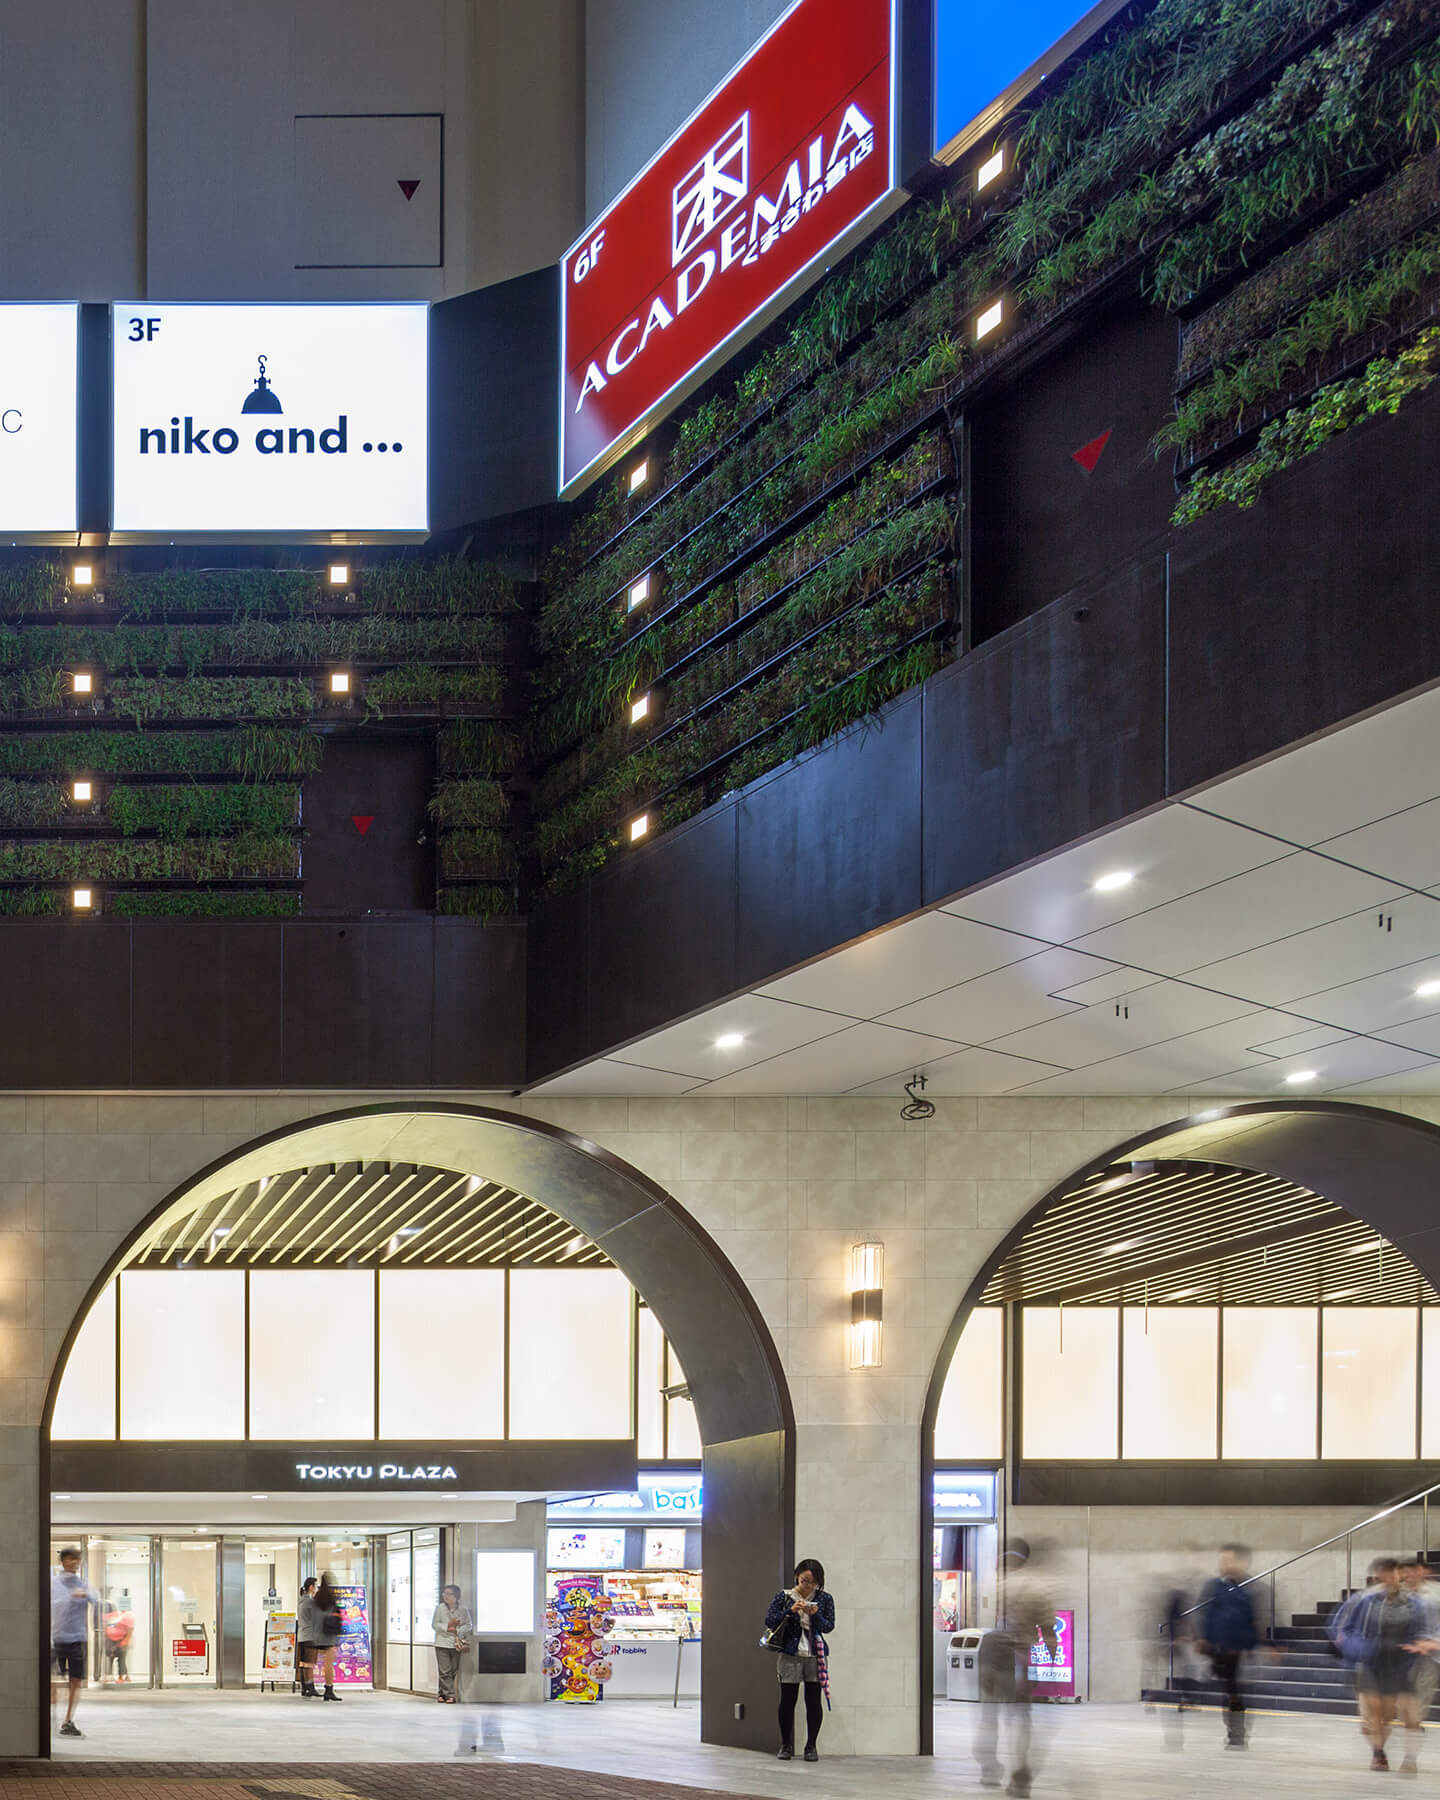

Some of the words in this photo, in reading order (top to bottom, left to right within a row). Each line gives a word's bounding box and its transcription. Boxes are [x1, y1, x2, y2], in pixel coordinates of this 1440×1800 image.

[573, 231, 605, 284] 6F
[574, 102, 875, 414] ACADEMIA
[128, 317, 162, 342] 3F
[139, 415, 240, 455] niko
[255, 415, 348, 455] and
[295, 1464, 372, 1480] TOKYU
[379, 1464, 457, 1480] PLAZA
